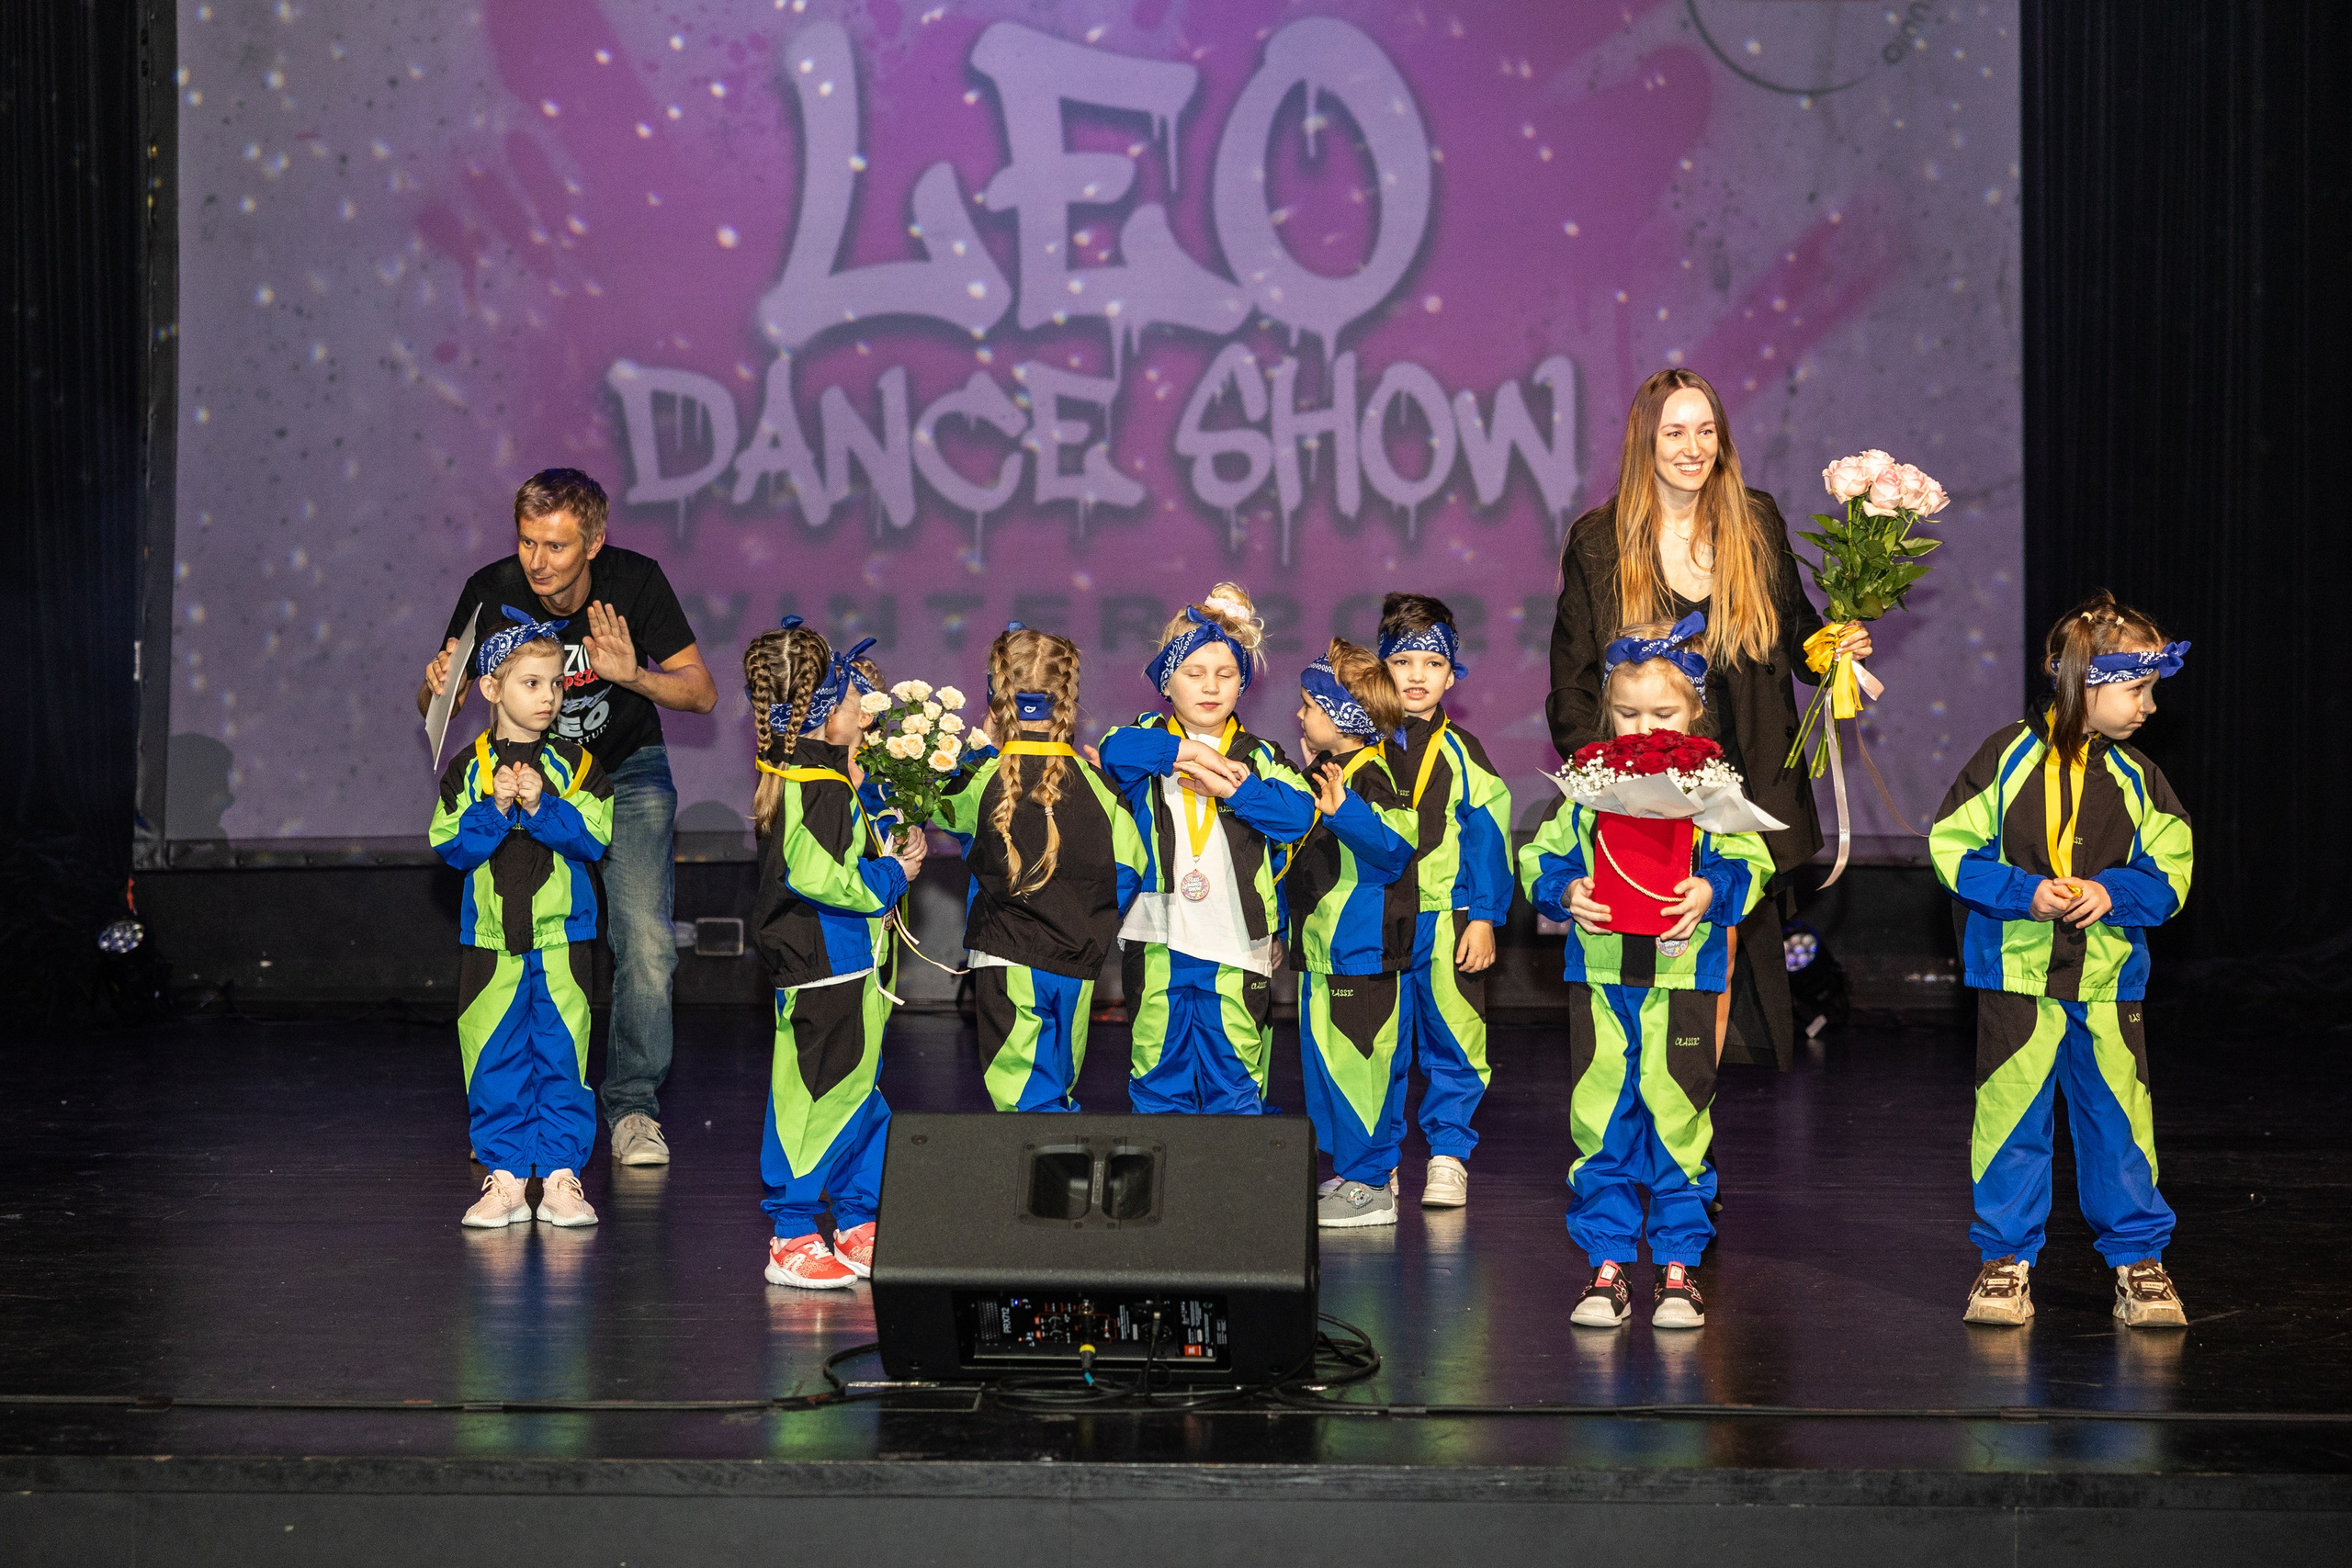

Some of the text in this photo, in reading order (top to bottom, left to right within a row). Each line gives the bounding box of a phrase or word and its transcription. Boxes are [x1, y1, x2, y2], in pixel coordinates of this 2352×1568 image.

[761, 17, 1431, 366] LEO
[607, 343, 1578, 537] DANCE SHOW
